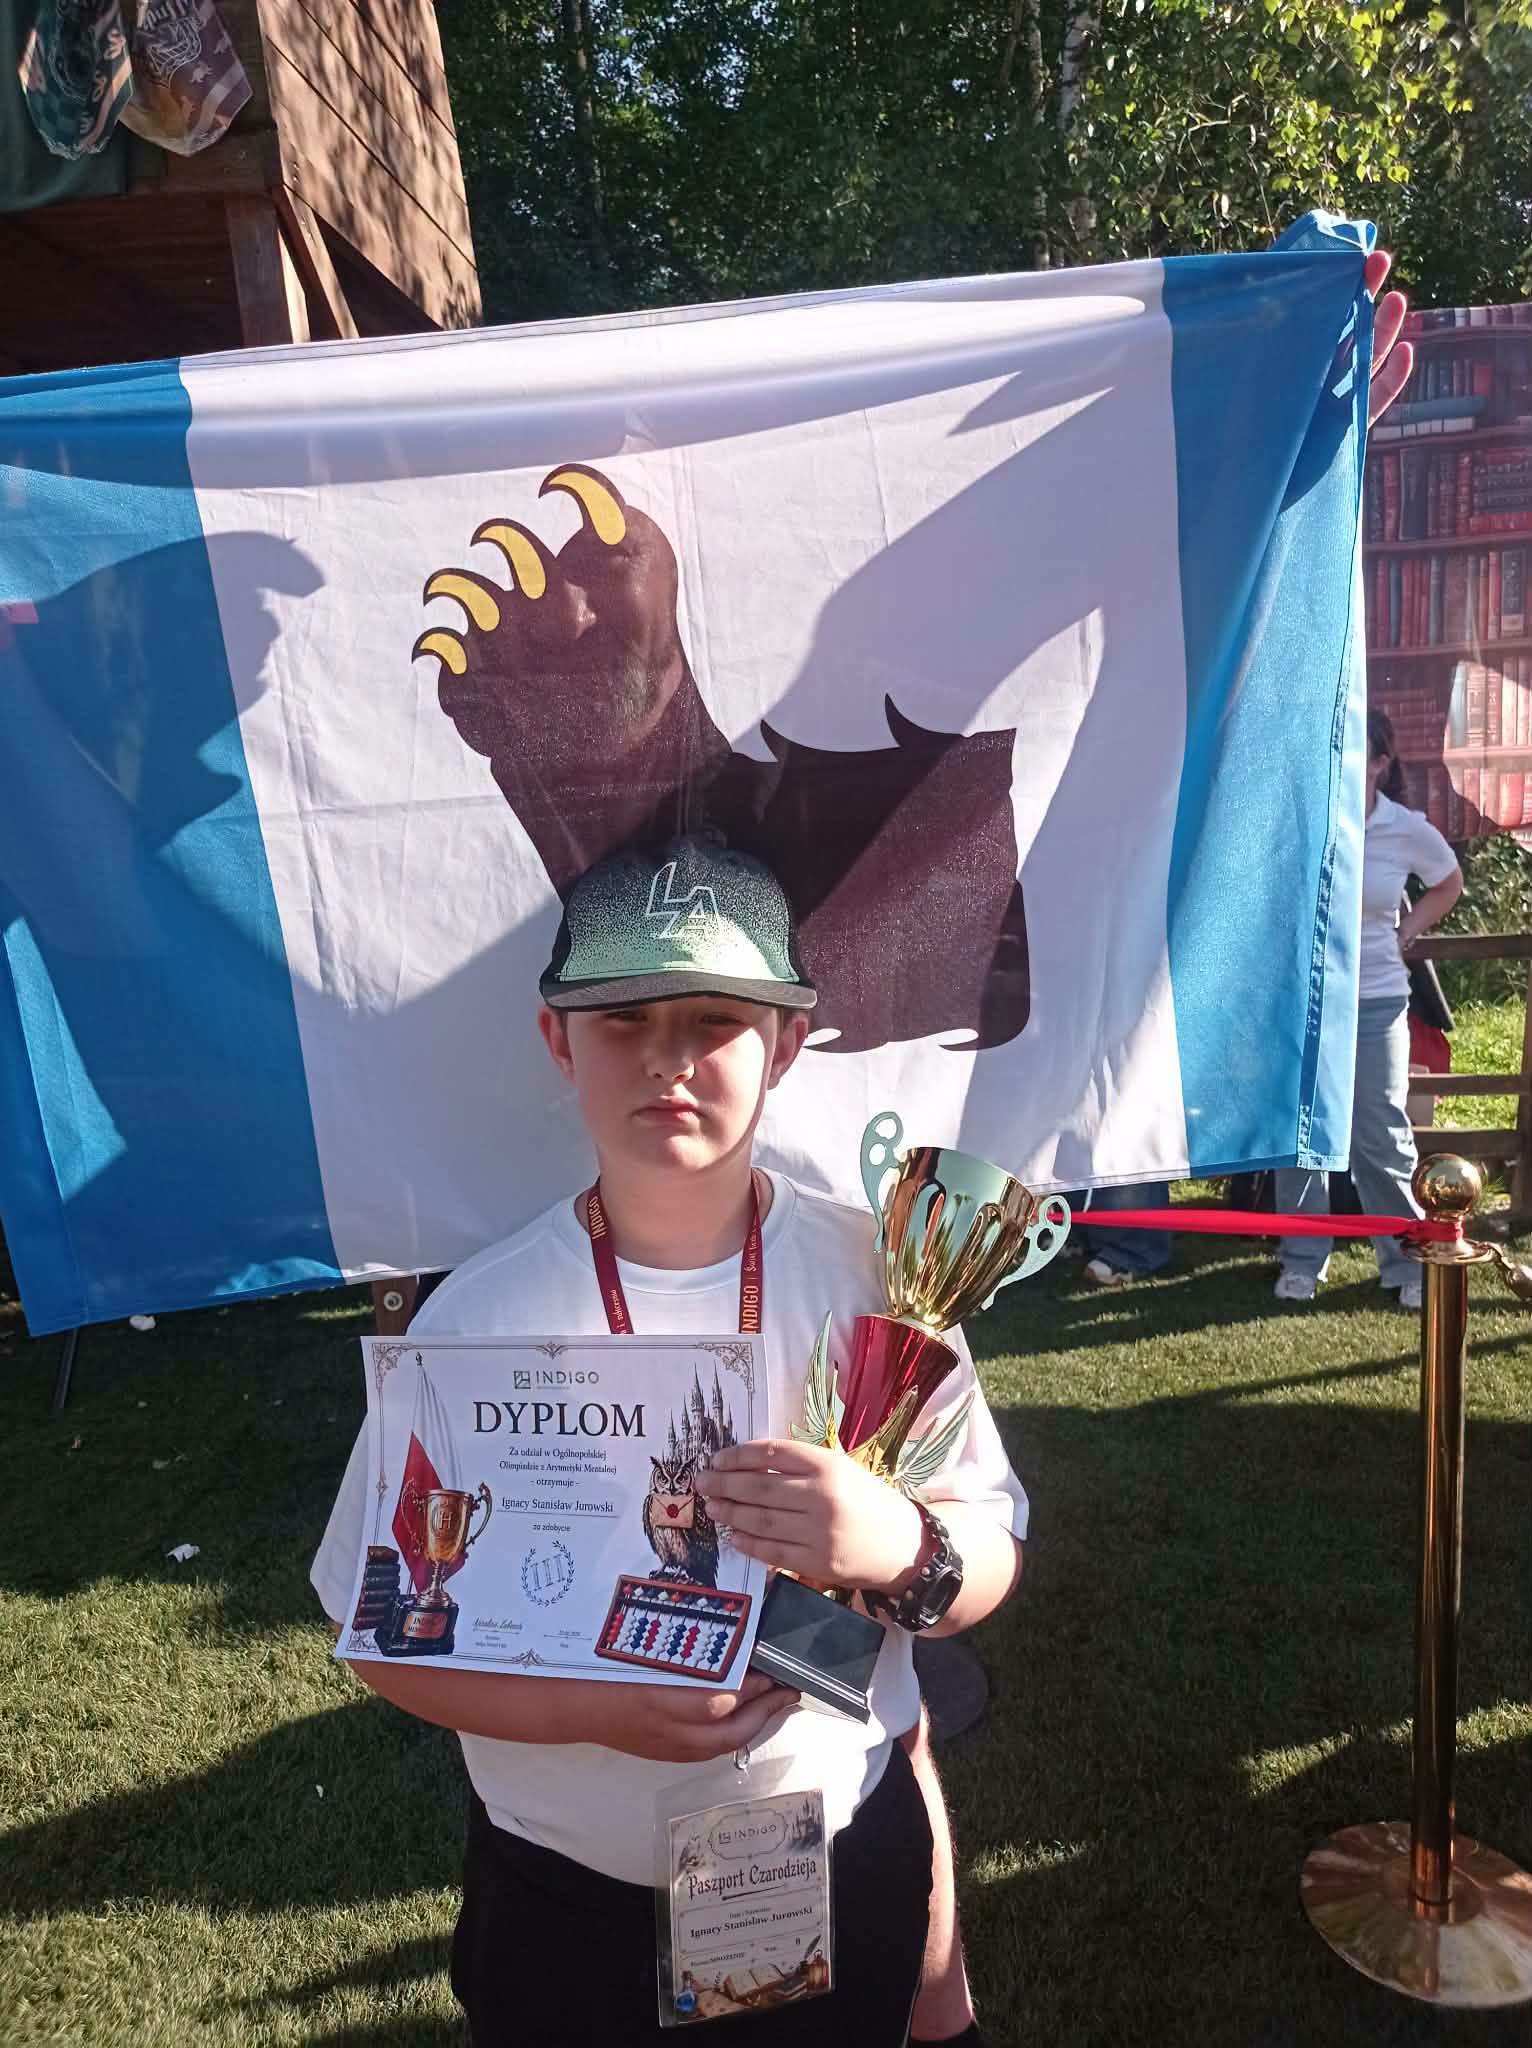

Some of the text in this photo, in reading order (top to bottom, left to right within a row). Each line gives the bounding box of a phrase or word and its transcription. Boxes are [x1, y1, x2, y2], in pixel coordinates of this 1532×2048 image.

[588, 1195, 608, 1240] INDIGO
[741, 1285, 758, 1334] INDIGO
[535, 1370, 600, 1385] INDIGO
[472, 1401, 647, 1438] DYPLOM
[509, 1447, 519, 1456] Za
[552, 1447, 607, 1461] Ogólnopolskiej
[499, 1460, 539, 1472] Olimpiadzie
[545, 1463, 582, 1474] Arytmetyki
[584, 1463, 617, 1475] Mentalnej
[536, 1479, 574, 1488] otrzymuje
[502, 1497, 614, 1513] Ignacy Stanisław Jurowski
[542, 1523, 571, 1533] zdobycie
[734, 1824, 777, 1839] INDIGO
[687, 1858, 817, 1900] Paszport Czarodzieja
[690, 1926, 722, 1938] Ignacy
[771, 1906, 813, 1921] Jurowski
